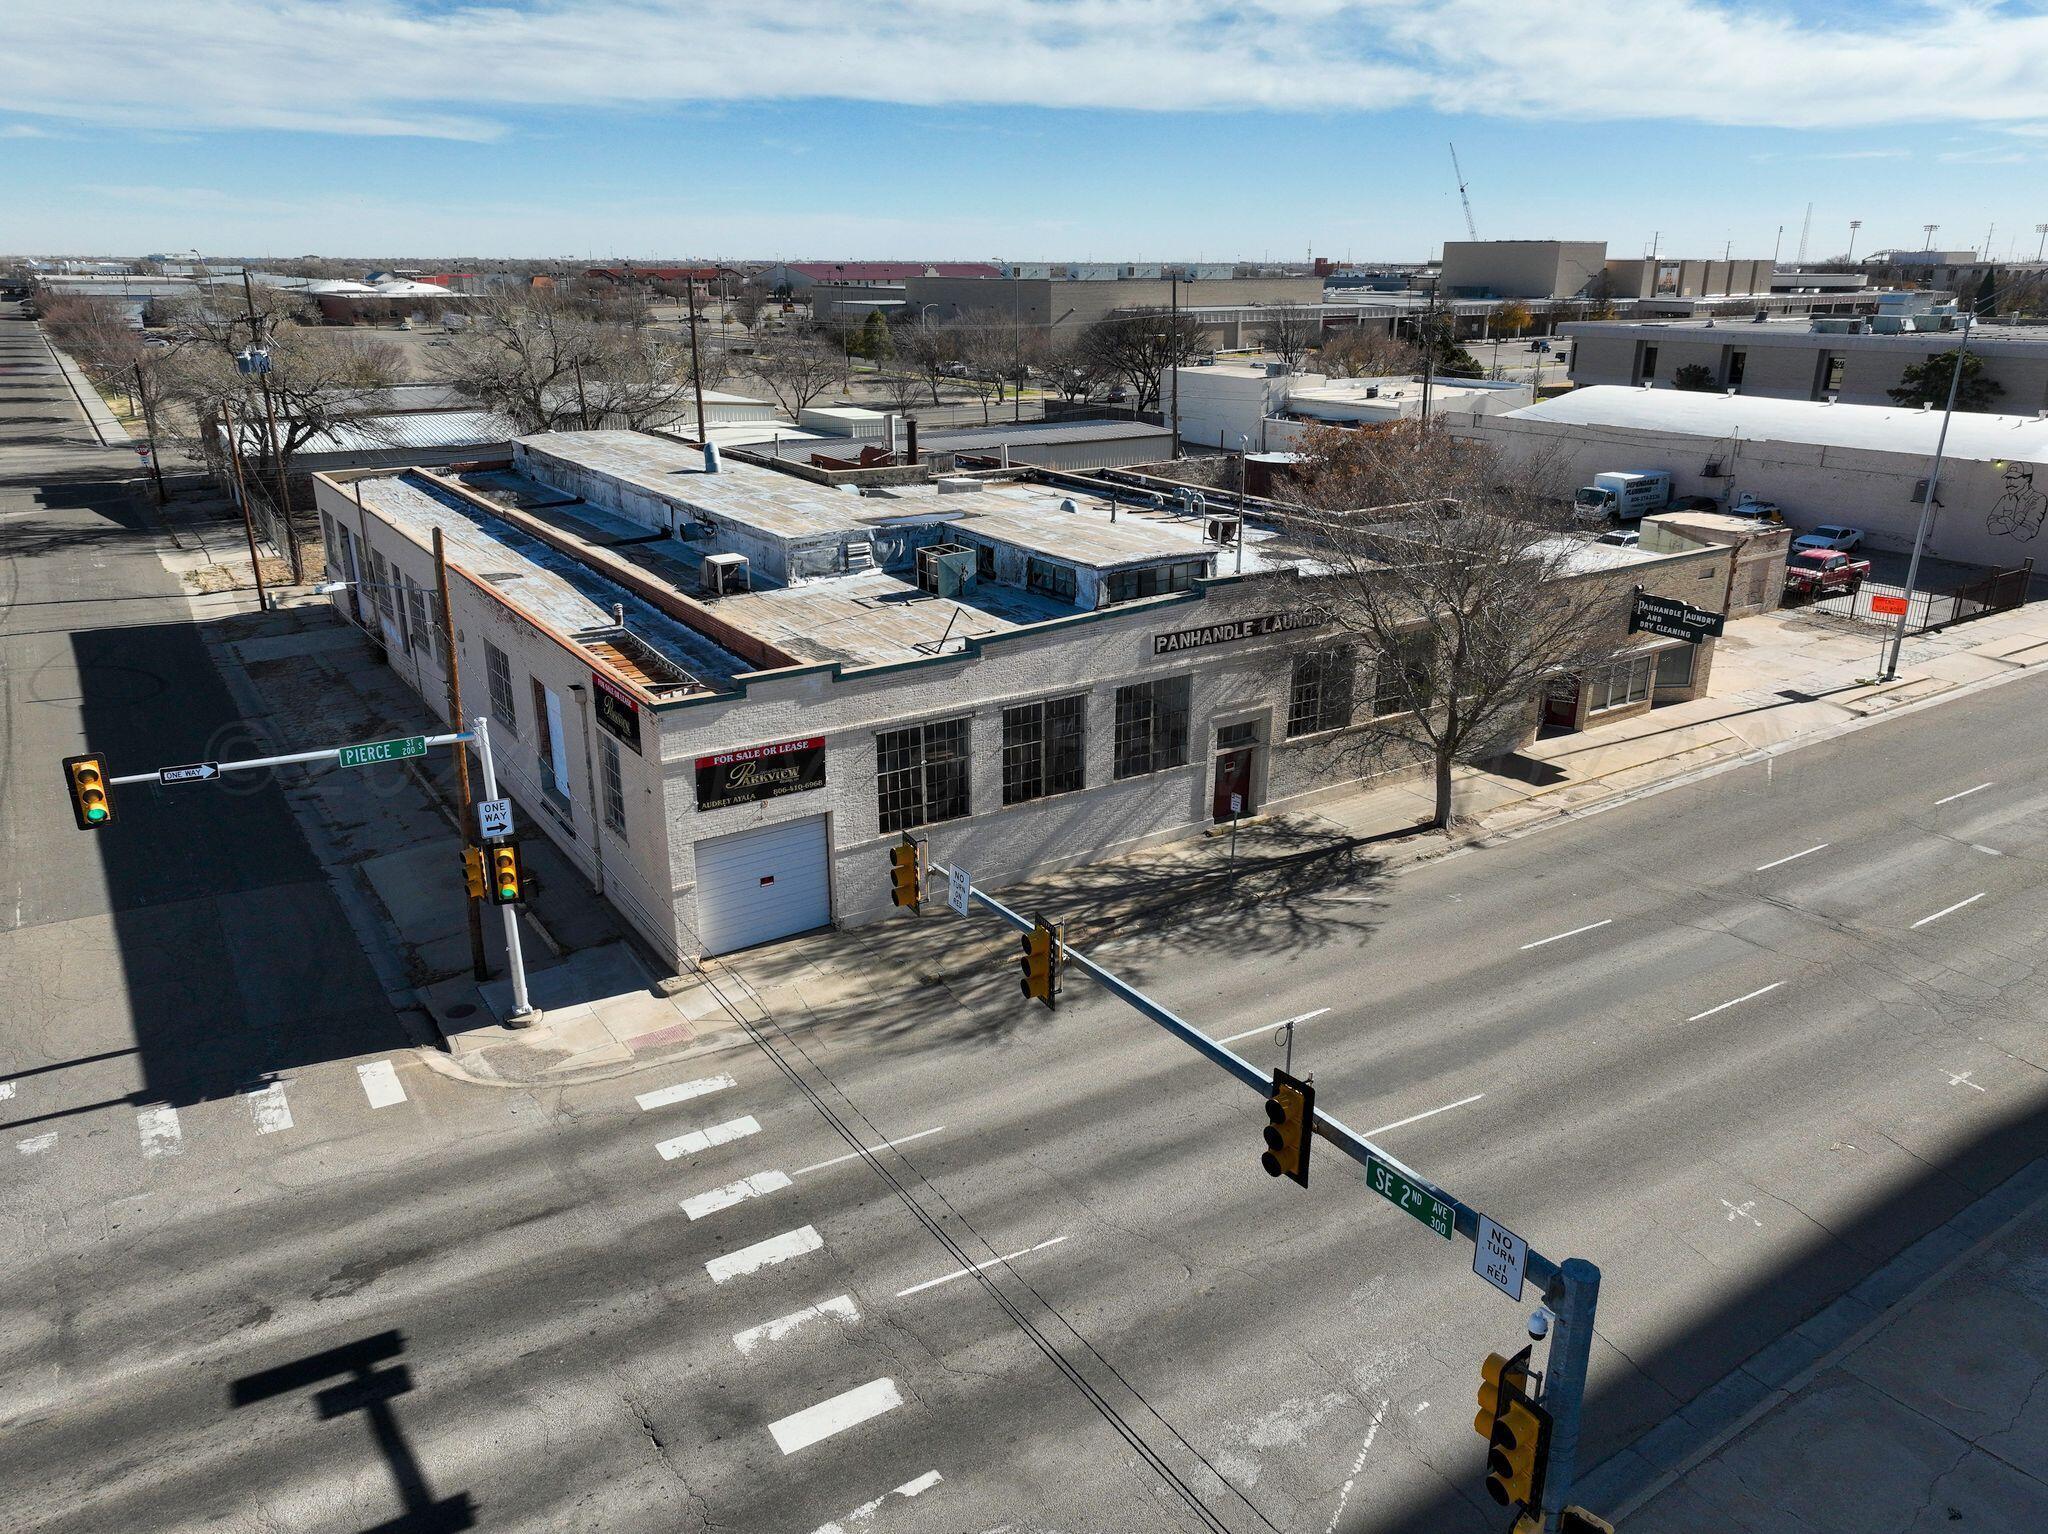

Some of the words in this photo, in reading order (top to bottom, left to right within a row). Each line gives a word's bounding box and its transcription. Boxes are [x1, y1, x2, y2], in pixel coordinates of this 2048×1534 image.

[1637, 600, 1682, 618] PANHANDLE
[1683, 610, 1717, 627] LAUNDRY
[1647, 613, 1662, 623] AND
[1156, 621, 1254, 653] PANHANDLE
[1640, 621, 1654, 630] DRY
[1656, 624, 1691, 639] CLEANING
[346, 746, 391, 765] PIERCE
[406, 739, 415, 747] ST
[402, 746, 416, 755] 200
[418, 742, 423, 750] S
[714, 755, 734, 765] FOR
[736, 750, 760, 761] SALE
[763, 746, 777, 756] OR
[780, 740, 809, 753] LEASE
[166, 771, 183, 780] ONE
[184, 768, 202, 778] WAY
[484, 802, 506, 813] ONE
[701, 798, 732, 810] AUDREY
[733, 793, 757, 804] AYALA
[485, 811, 507, 822] WAY
[954, 870, 965, 883] NO
[1375, 1167, 1394, 1197] SE
[1400, 1184, 1423, 1209] 2ND
[1432, 1201, 1448, 1220] AVE
[1430, 1215, 1446, 1235] 300
[1491, 1227, 1513, 1250] NO
[1487, 1239, 1515, 1266] TURN
[1486, 1264, 1508, 1286] RED
